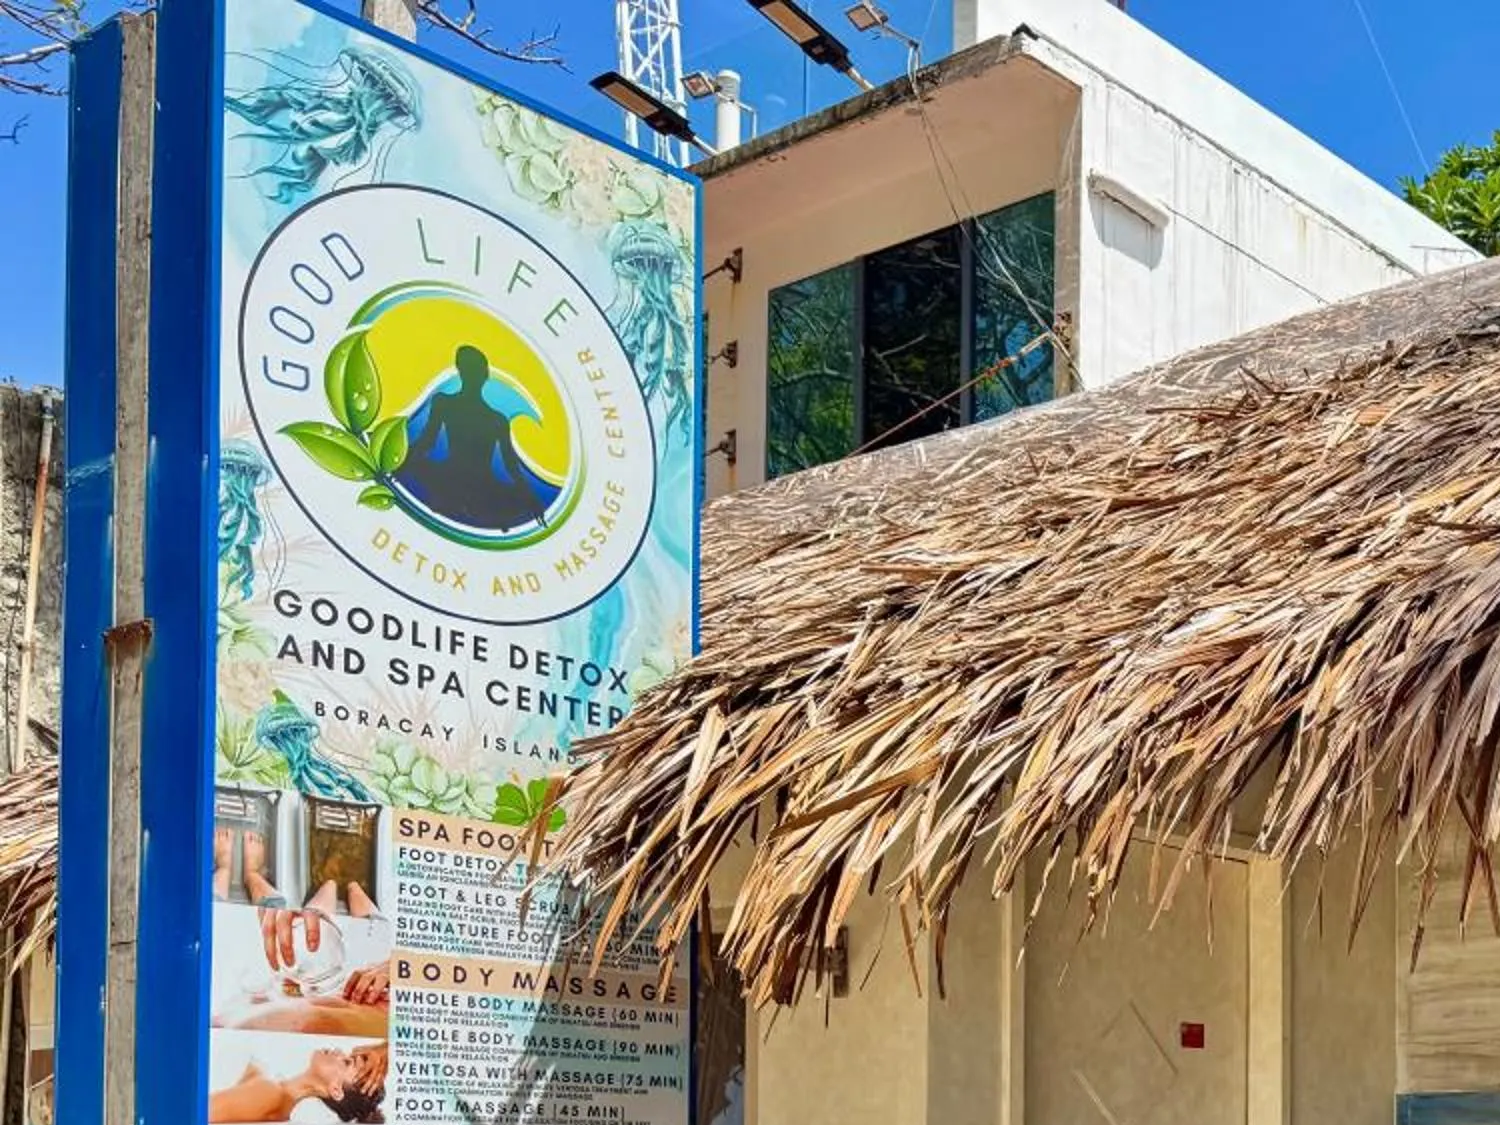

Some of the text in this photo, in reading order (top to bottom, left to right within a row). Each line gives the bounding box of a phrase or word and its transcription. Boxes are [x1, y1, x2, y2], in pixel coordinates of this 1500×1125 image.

[262, 216, 581, 392] GOOD LIFE
[372, 346, 626, 597] DETOX AND MASSAGE CENTER
[273, 589, 629, 695] GOODLIFE DETOX
[277, 634, 624, 729] AND SPA CENTER
[315, 701, 455, 741] BORACAY
[399, 818, 450, 843] SPA
[400, 848, 446, 865] FOOT
[400, 883, 447, 899] FOOT
[456, 890, 466, 903] &
[475, 892, 506, 907] LEG
[397, 918, 499, 940] SIGNATURE
[398, 960, 677, 1003] BODY MASSAGE
[396, 990, 459, 1007] WHOLE
[467, 997, 515, 1011] BODY
[523, 1001, 606, 1019] MASSAGE
[396, 1026, 606, 1051] WHOLE BODY MASSAGE
[396, 1062, 479, 1079] VENTOSA
[487, 1067, 527, 1081] WITH
[395, 1098, 547, 1115] FOOT MASSAGE
